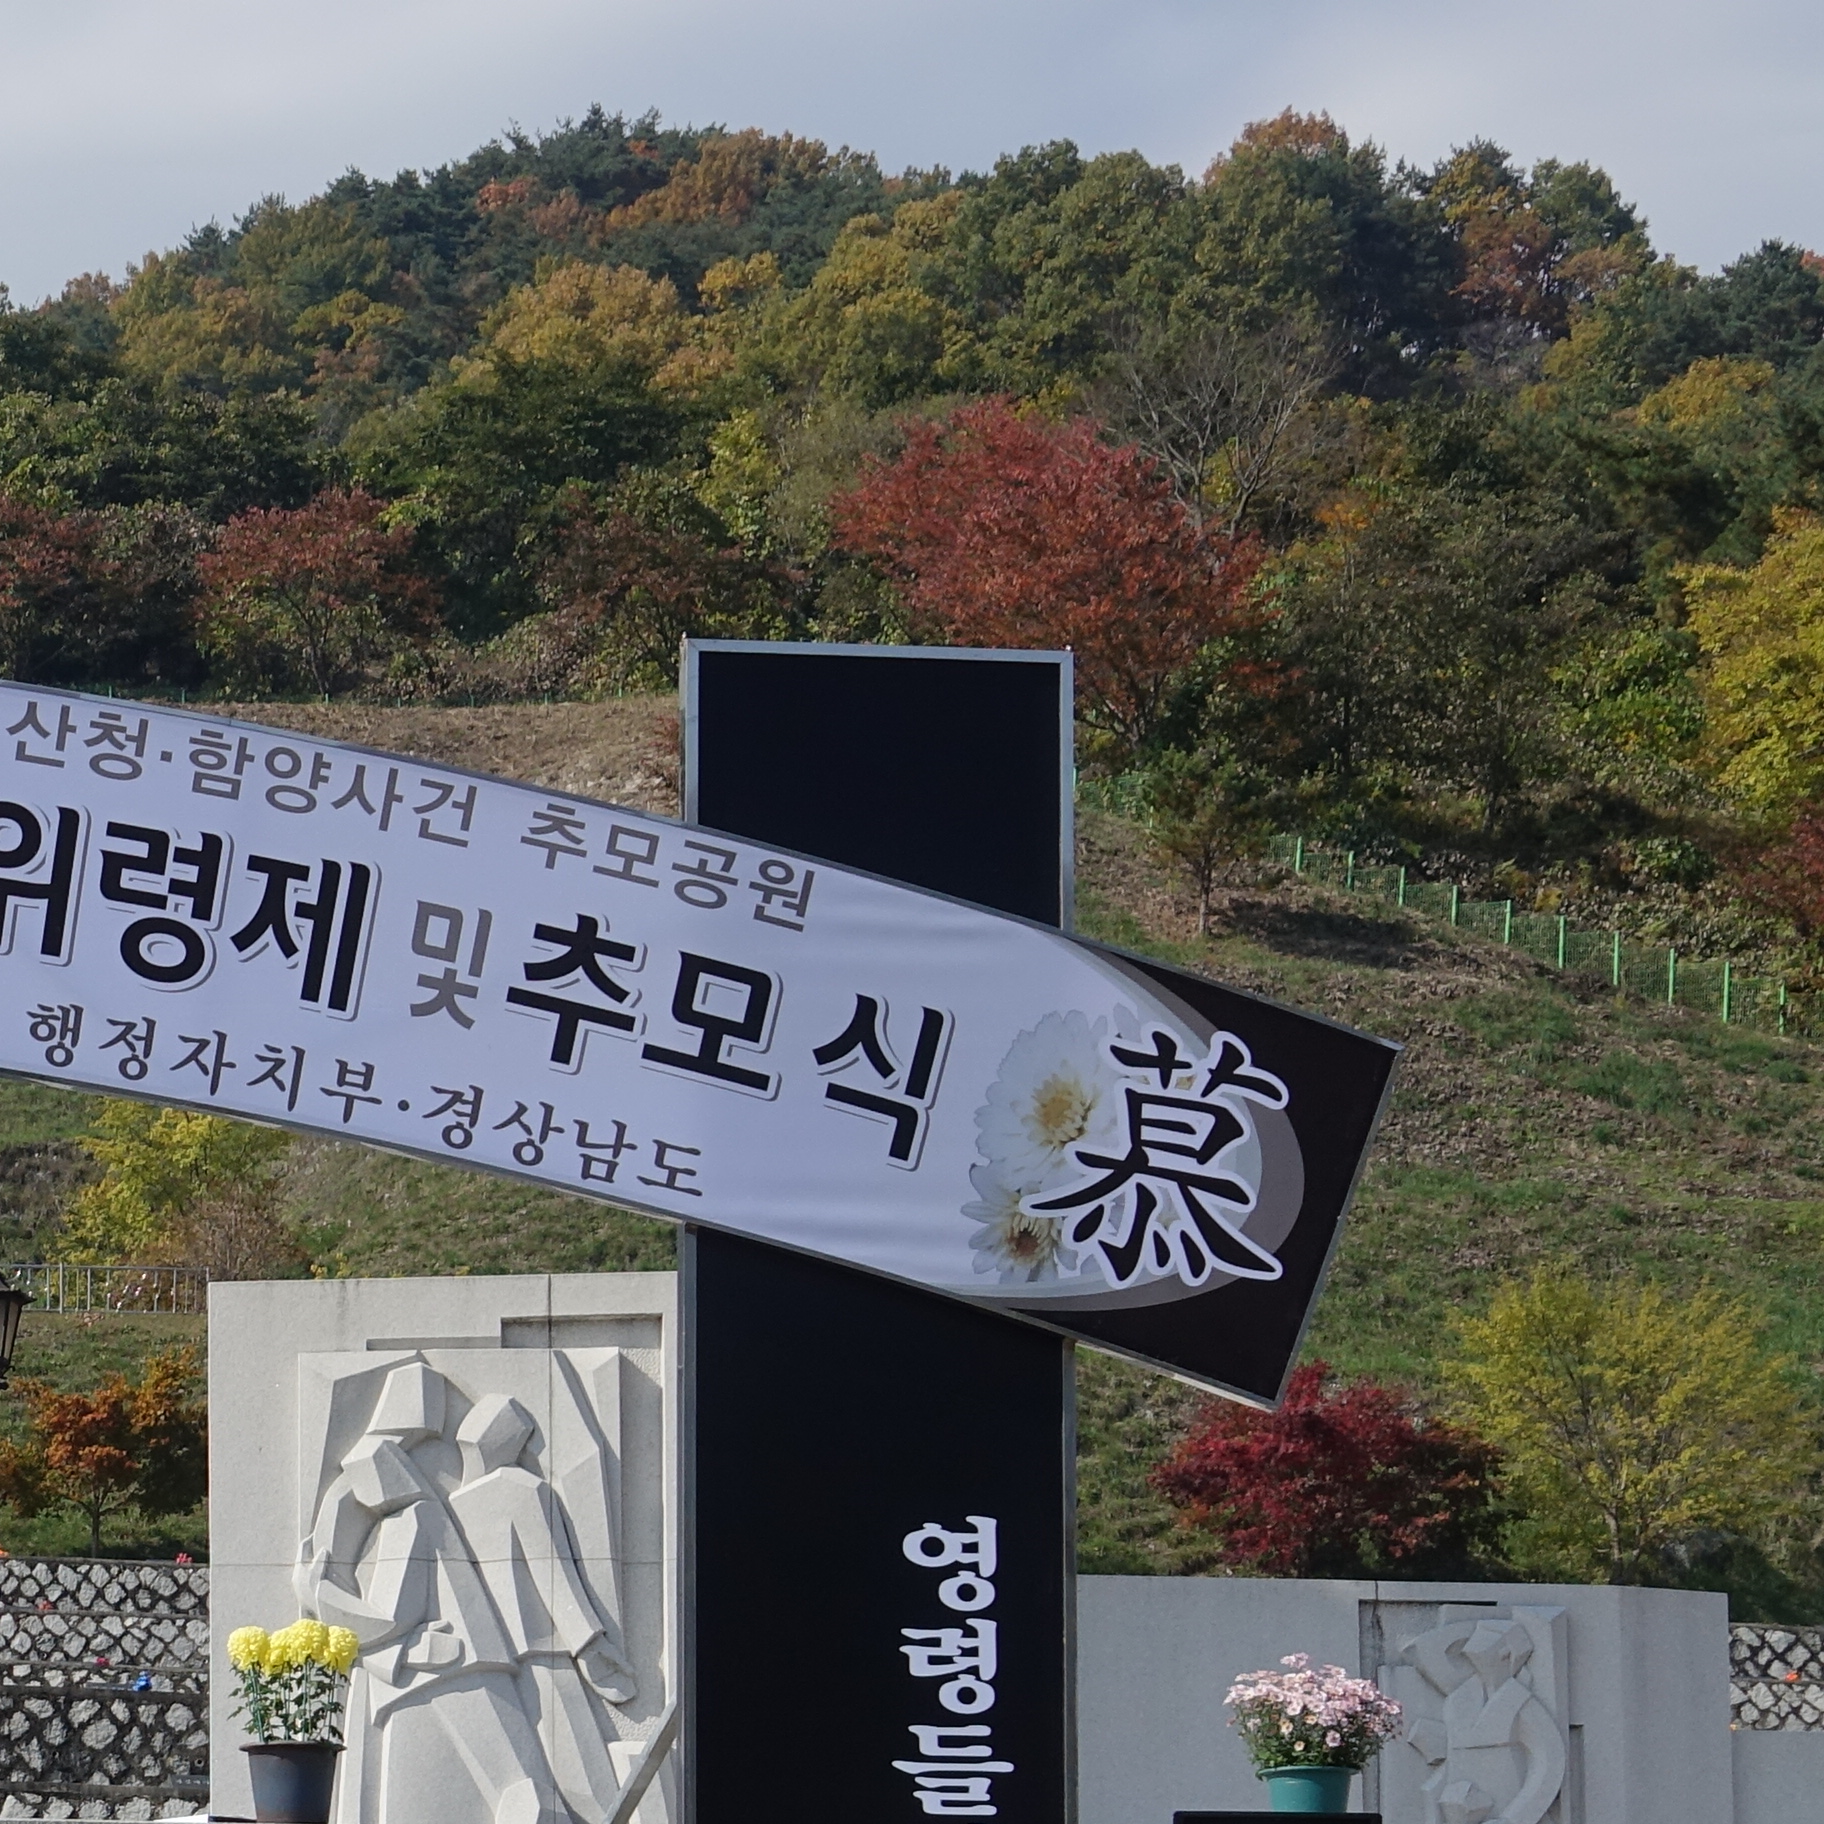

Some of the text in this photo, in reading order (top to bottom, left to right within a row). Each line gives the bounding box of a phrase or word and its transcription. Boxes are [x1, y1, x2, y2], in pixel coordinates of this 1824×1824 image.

[519, 800, 817, 933] 추모공원
[408, 899, 492, 1031] 및
[505, 912, 949, 1167] 추모식
[1021, 1028, 1290, 1287] 慕
